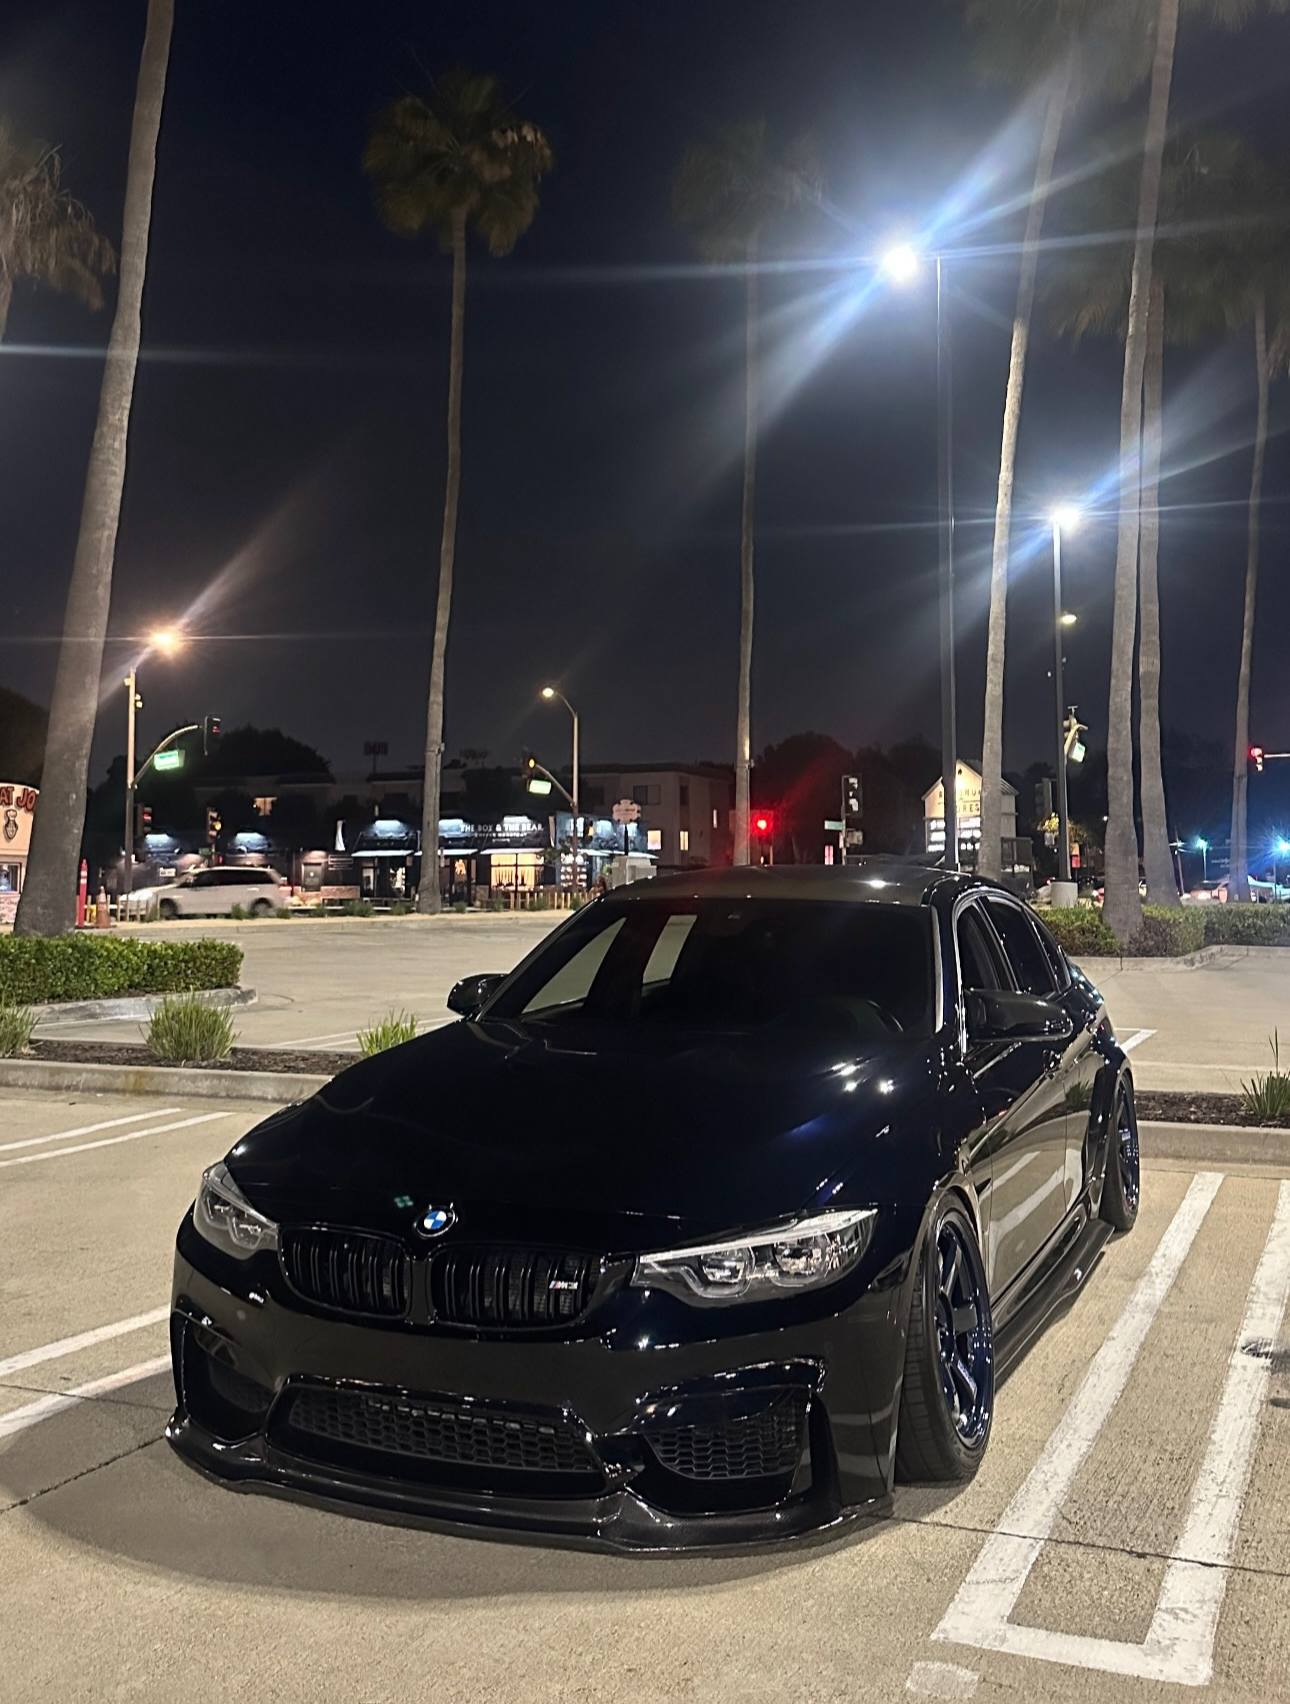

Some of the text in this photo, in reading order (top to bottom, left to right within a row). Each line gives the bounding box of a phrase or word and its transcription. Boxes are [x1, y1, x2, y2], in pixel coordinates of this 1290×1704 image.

[460, 823, 475, 832] THE
[503, 823, 520, 832] THE
[521, 823, 544, 832] BEAR
